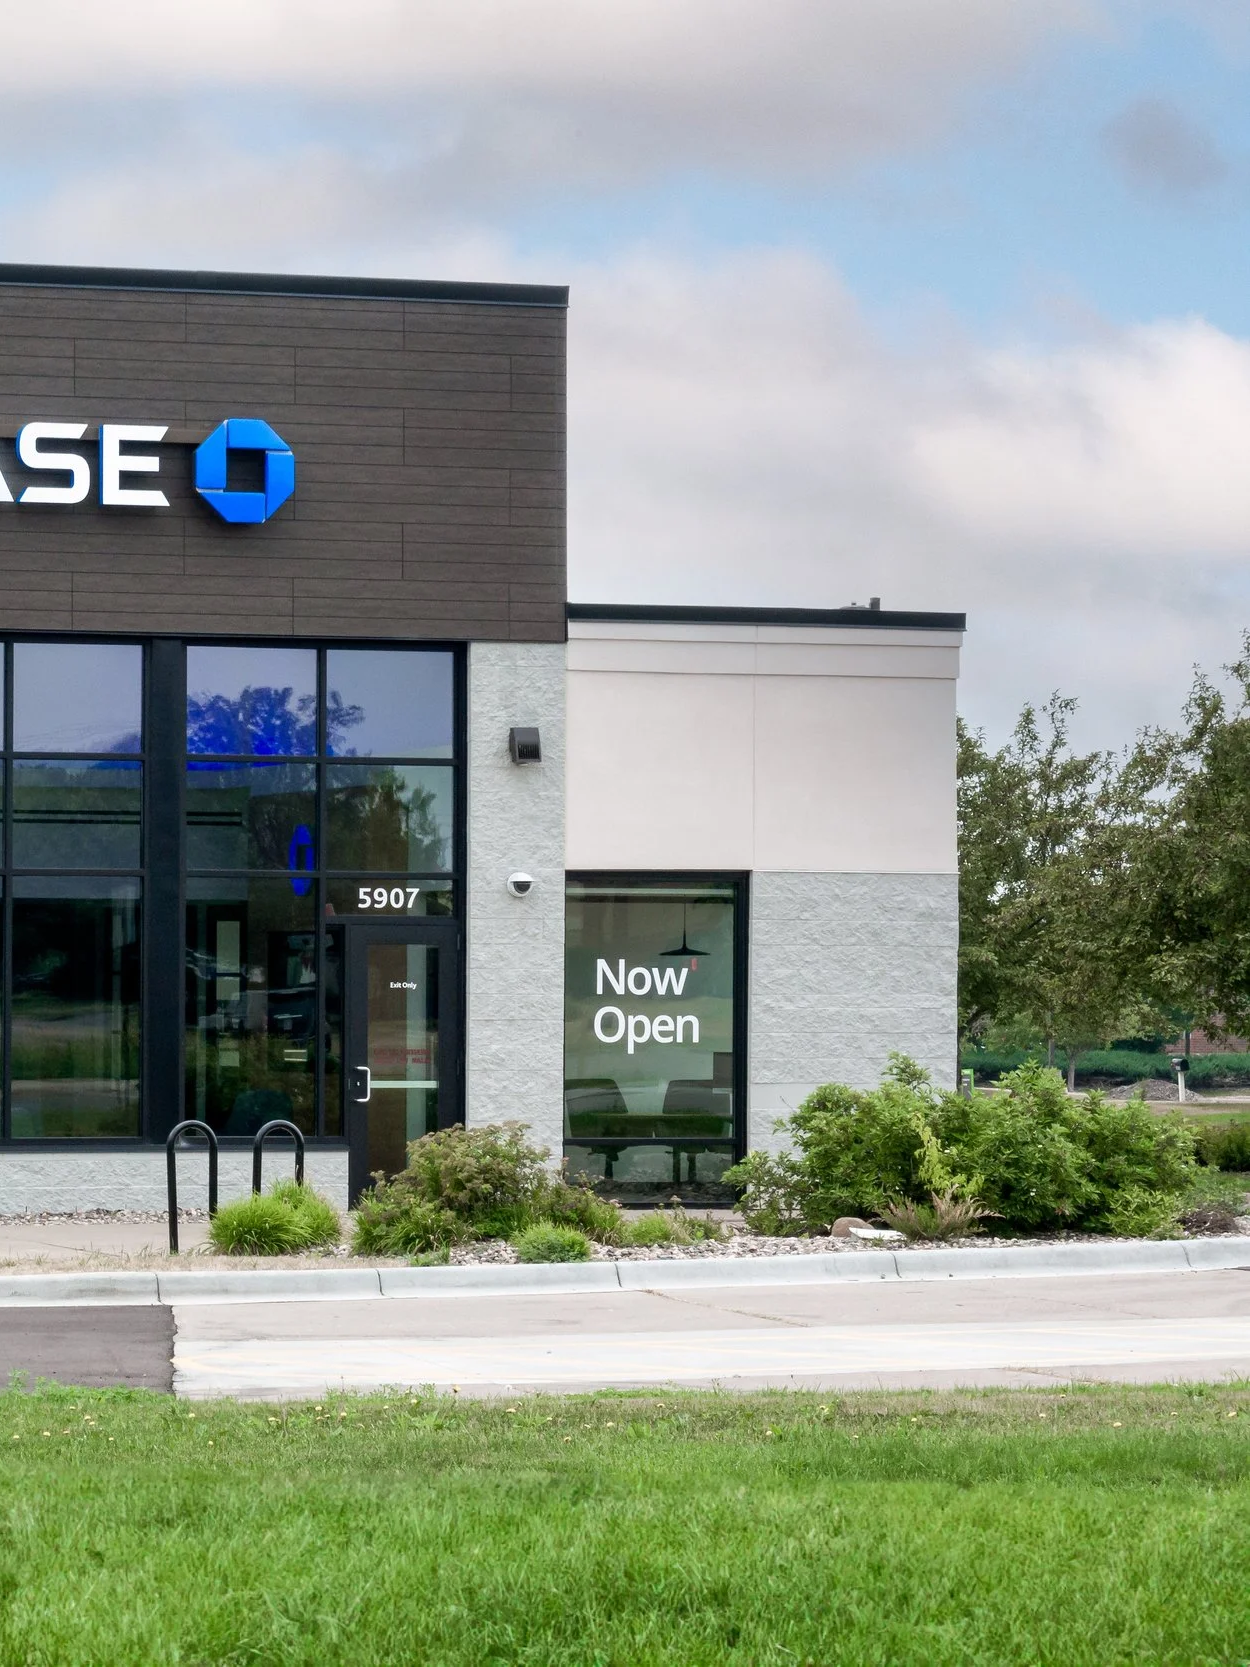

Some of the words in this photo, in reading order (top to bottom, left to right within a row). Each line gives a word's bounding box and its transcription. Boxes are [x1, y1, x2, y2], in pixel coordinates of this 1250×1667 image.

[358, 888, 420, 909] 5907
[402, 982, 417, 991] Only
[596, 958, 688, 996] Now
[593, 1005, 700, 1055] Open
